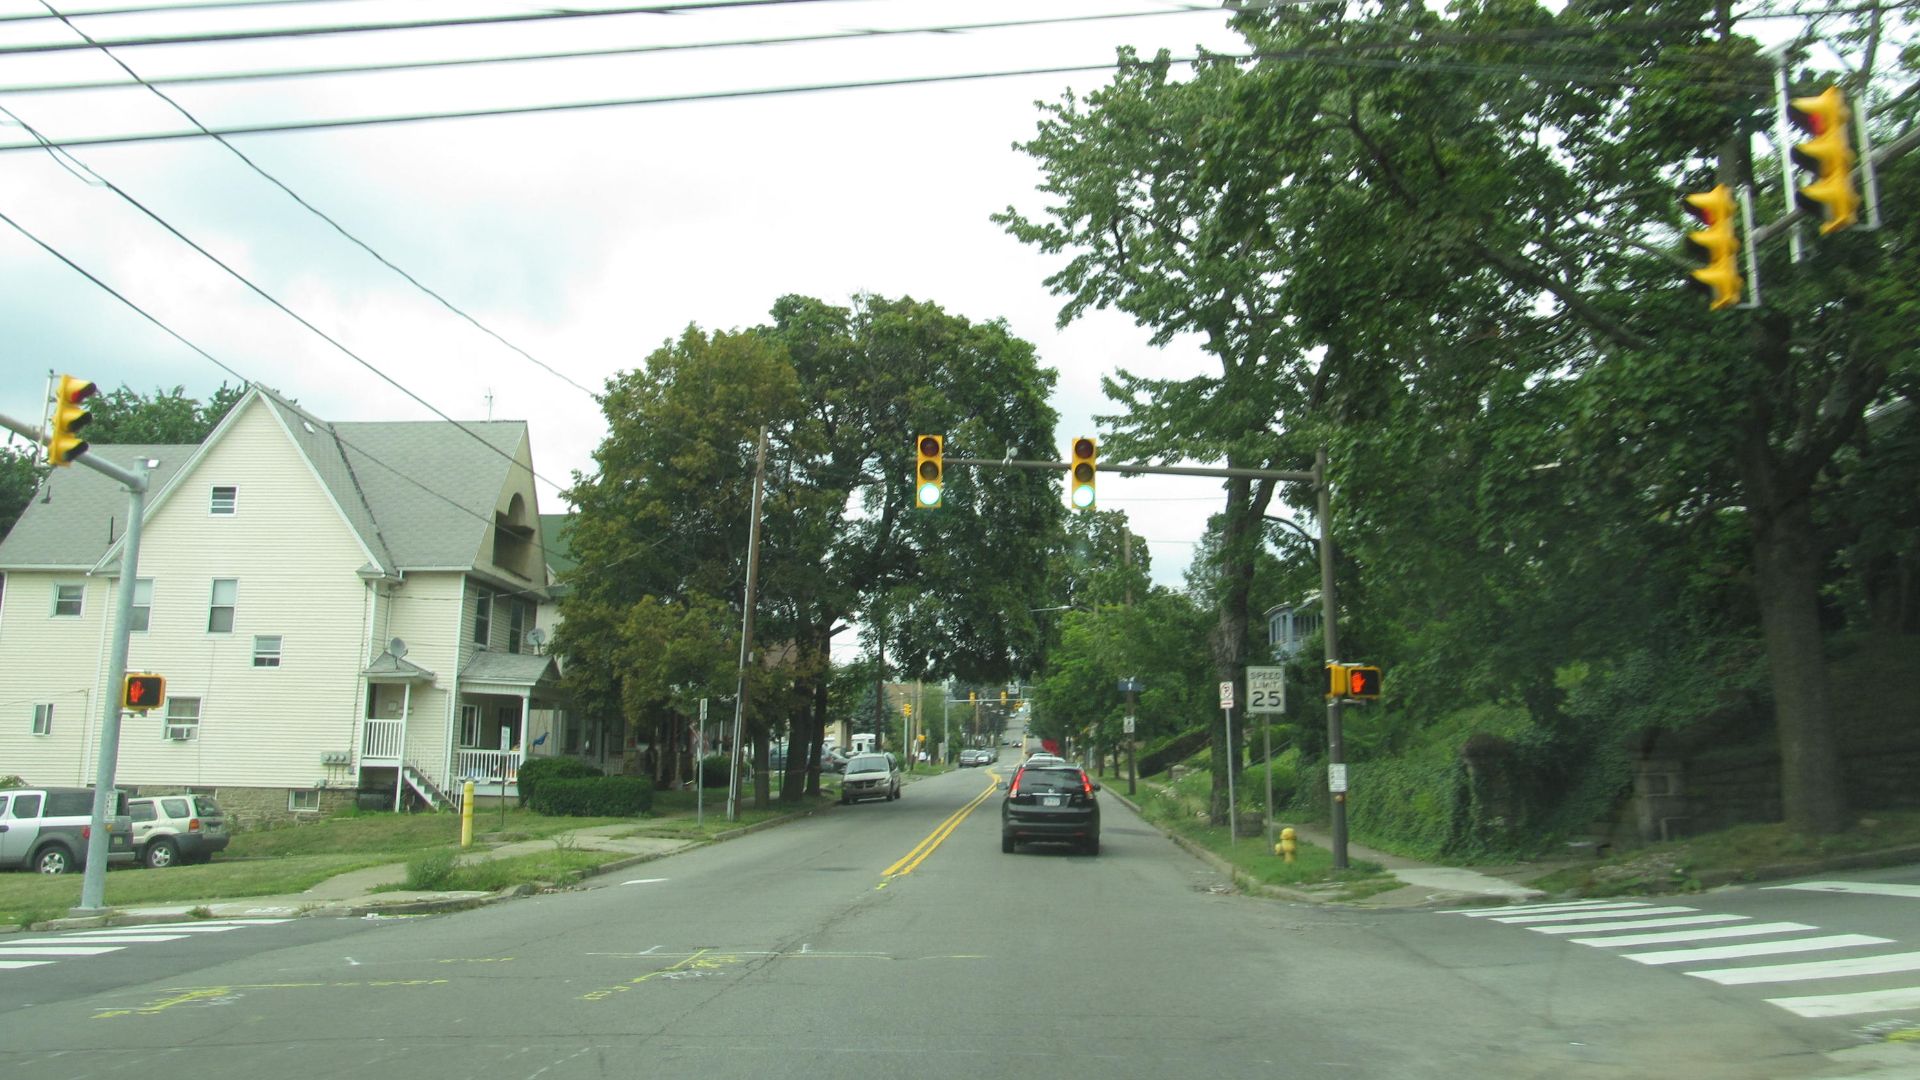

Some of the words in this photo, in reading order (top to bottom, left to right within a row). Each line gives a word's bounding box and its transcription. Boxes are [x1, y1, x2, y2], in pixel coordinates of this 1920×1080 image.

[1249, 671, 1281, 680] SPEED
[1252, 680, 1280, 689] LIMIT
[1252, 690, 1282, 707] 25
